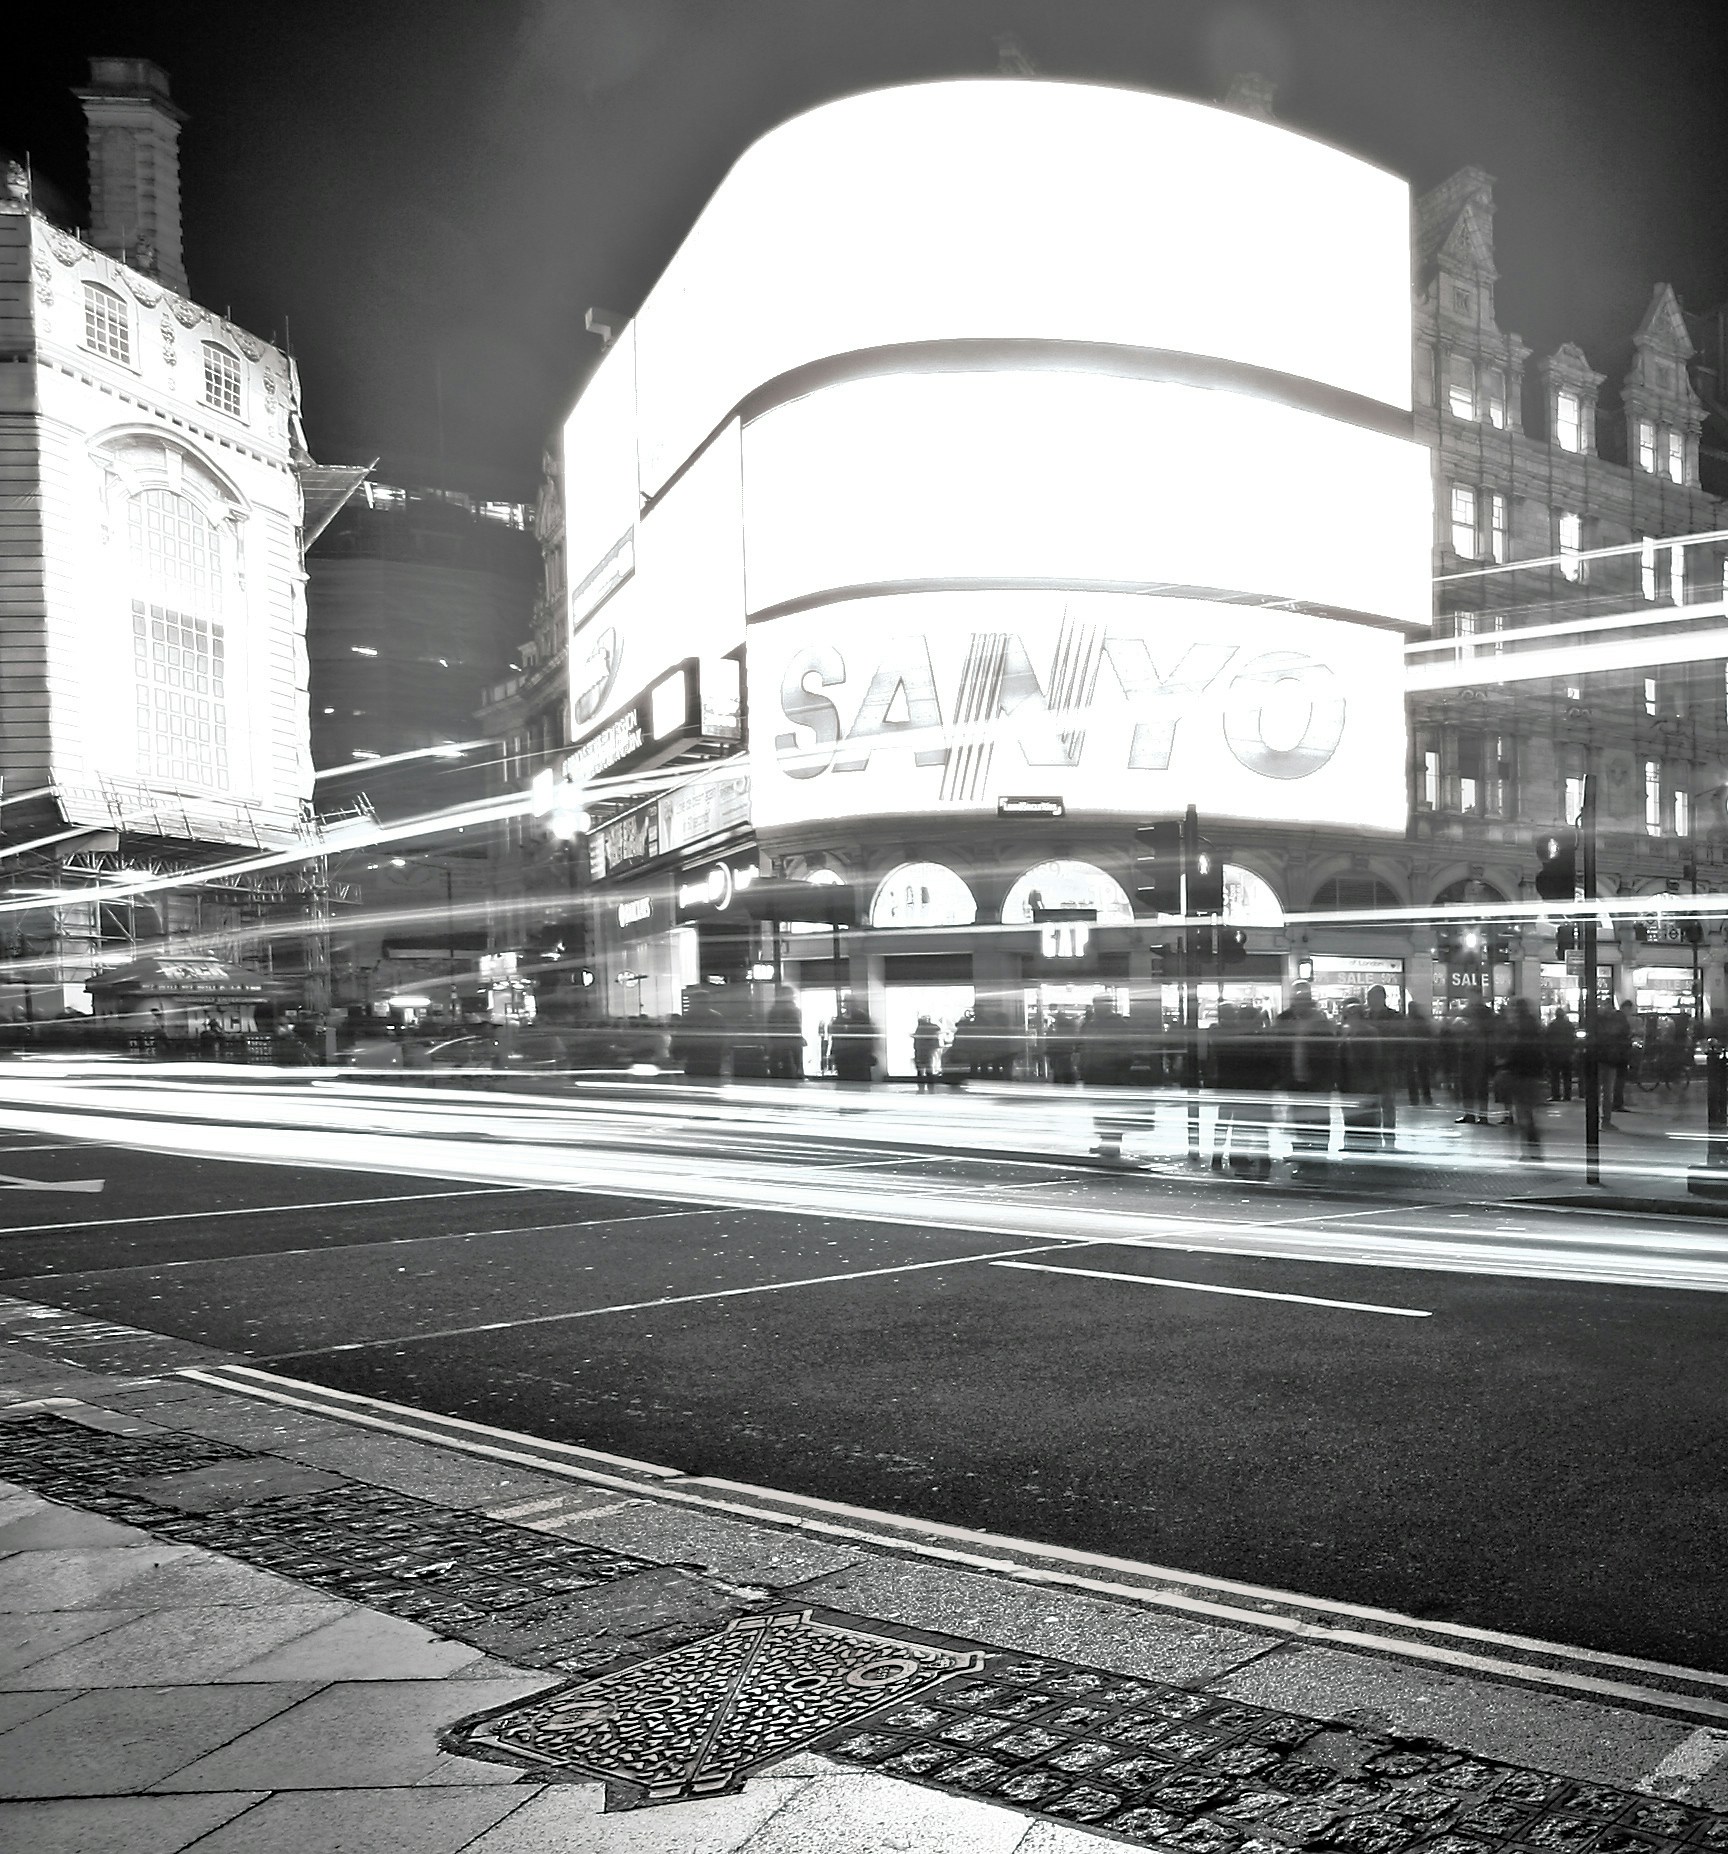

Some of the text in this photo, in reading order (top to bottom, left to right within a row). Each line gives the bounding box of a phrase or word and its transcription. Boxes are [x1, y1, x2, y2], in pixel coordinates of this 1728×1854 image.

[775, 612, 1346, 798] SANYO
[1337, 972, 1373, 983] SALE
[1452, 973, 1490, 987] SALE
